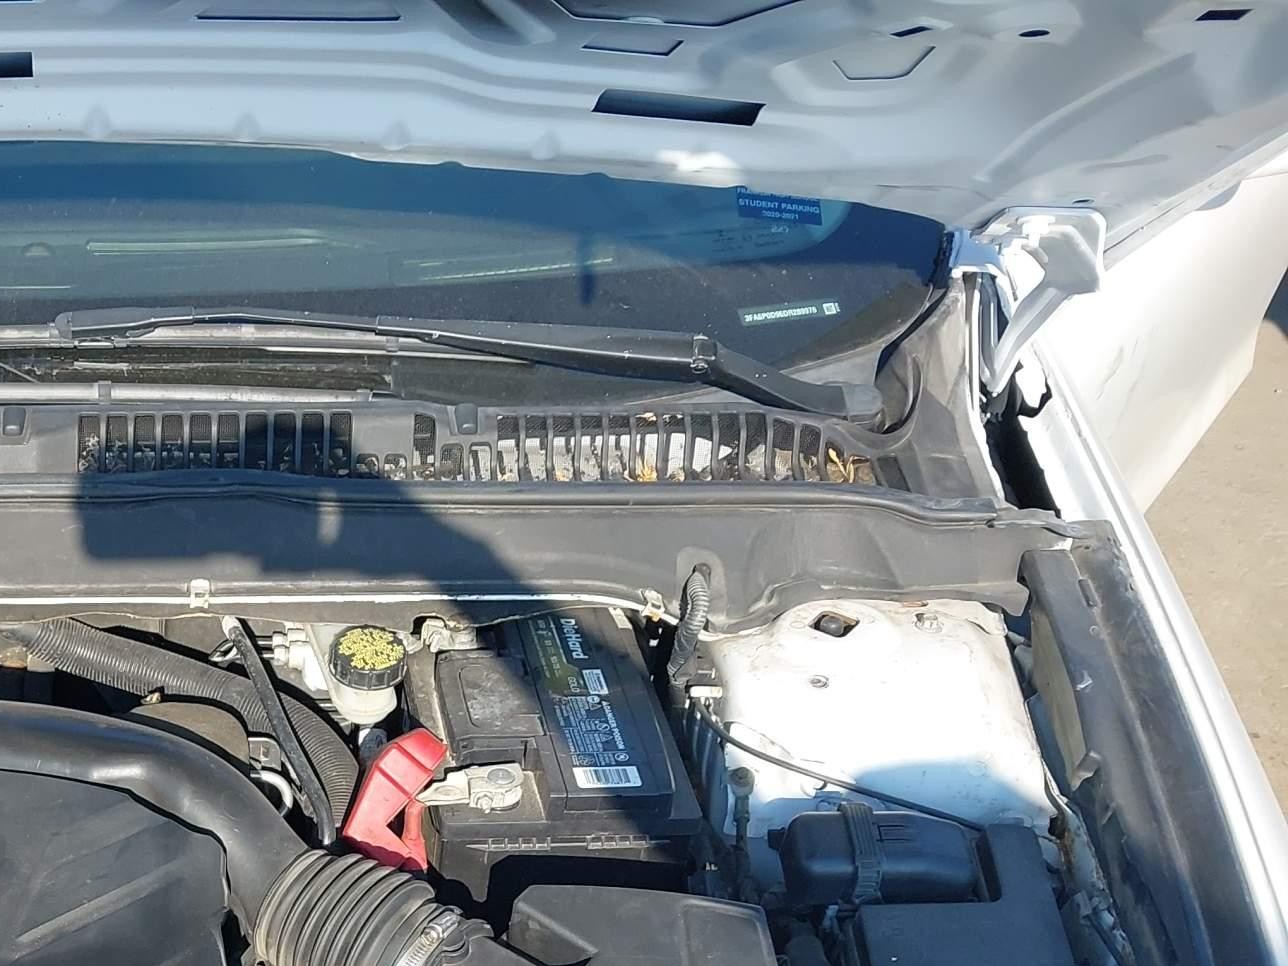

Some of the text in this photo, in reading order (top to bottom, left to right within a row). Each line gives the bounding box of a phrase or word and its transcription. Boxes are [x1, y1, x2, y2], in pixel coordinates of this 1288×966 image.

[739, 198, 819, 213] STUDENT PARKING
[560, 618, 589, 659] DieHard
[568, 676, 580, 693] GOLD
[604, 705, 617, 728] DANGER
